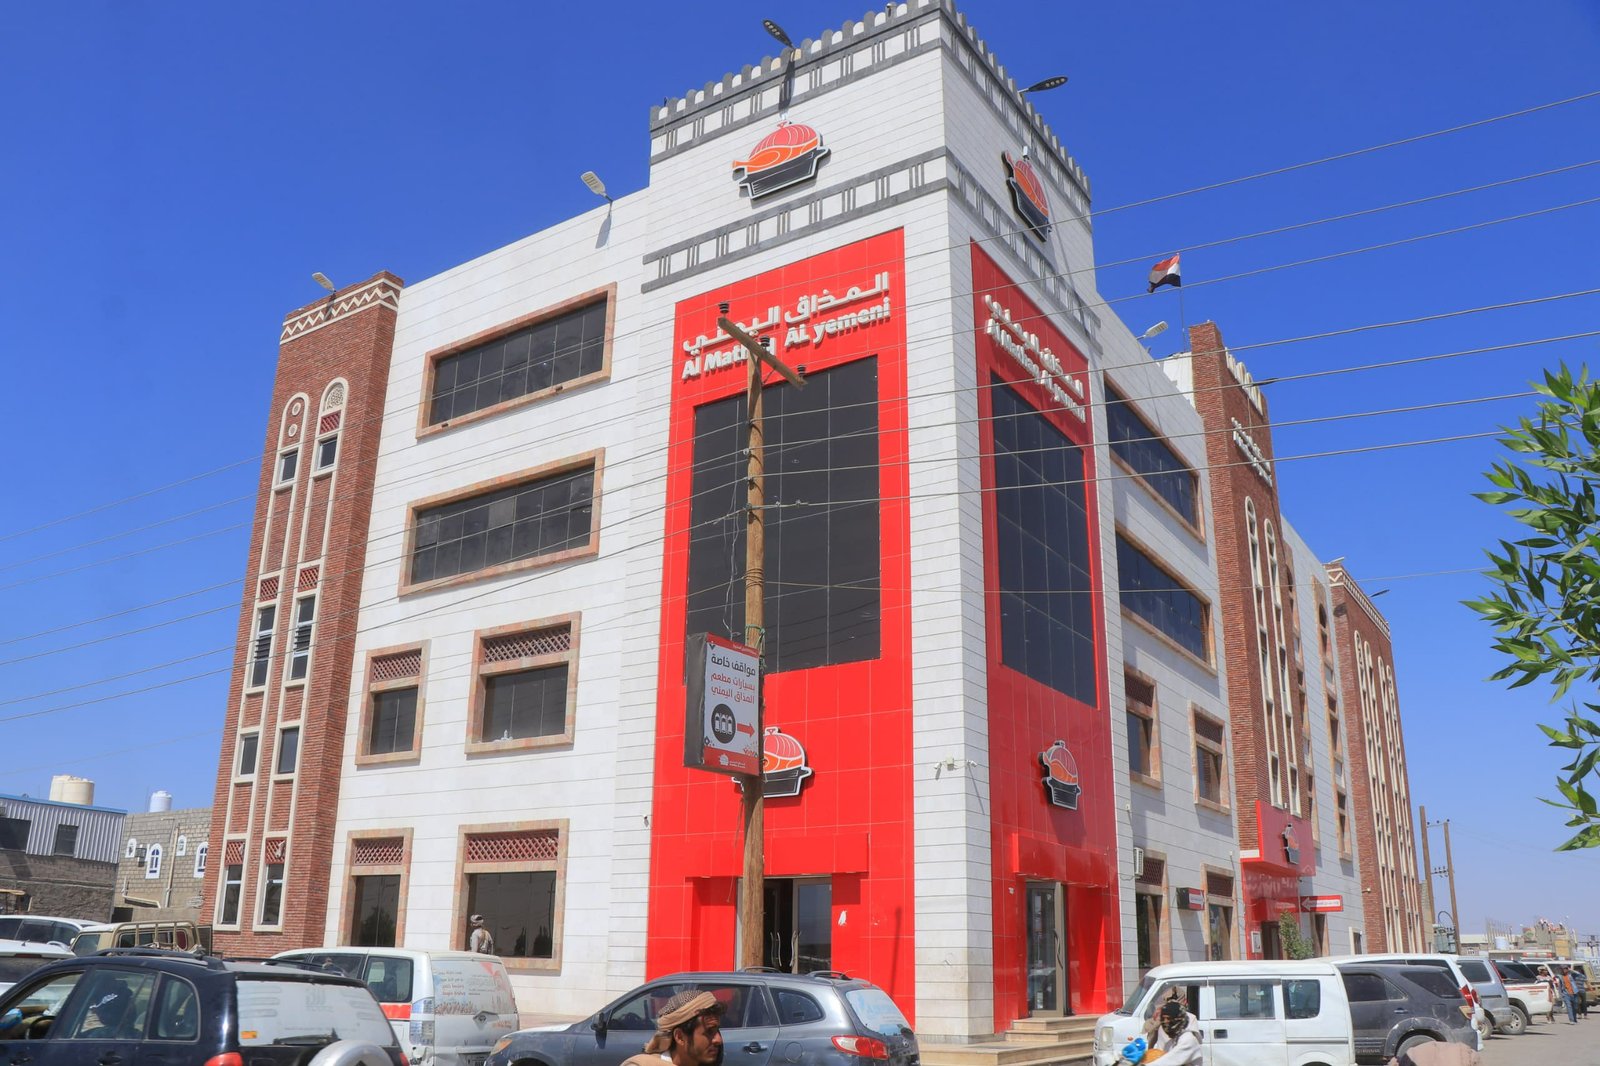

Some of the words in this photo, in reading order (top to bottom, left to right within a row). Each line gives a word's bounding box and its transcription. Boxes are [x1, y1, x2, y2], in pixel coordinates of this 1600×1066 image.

[784, 271, 890, 324] المذاق
[704, 337, 776, 372] Math
[812, 297, 891, 343] yemeni
[711, 653, 730, 668] خاصة
[731, 660, 756, 678] مواقف
[710, 672, 731, 683] مطعم
[711, 685, 733, 699] اليمني
[734, 691, 755, 704] المذاق
